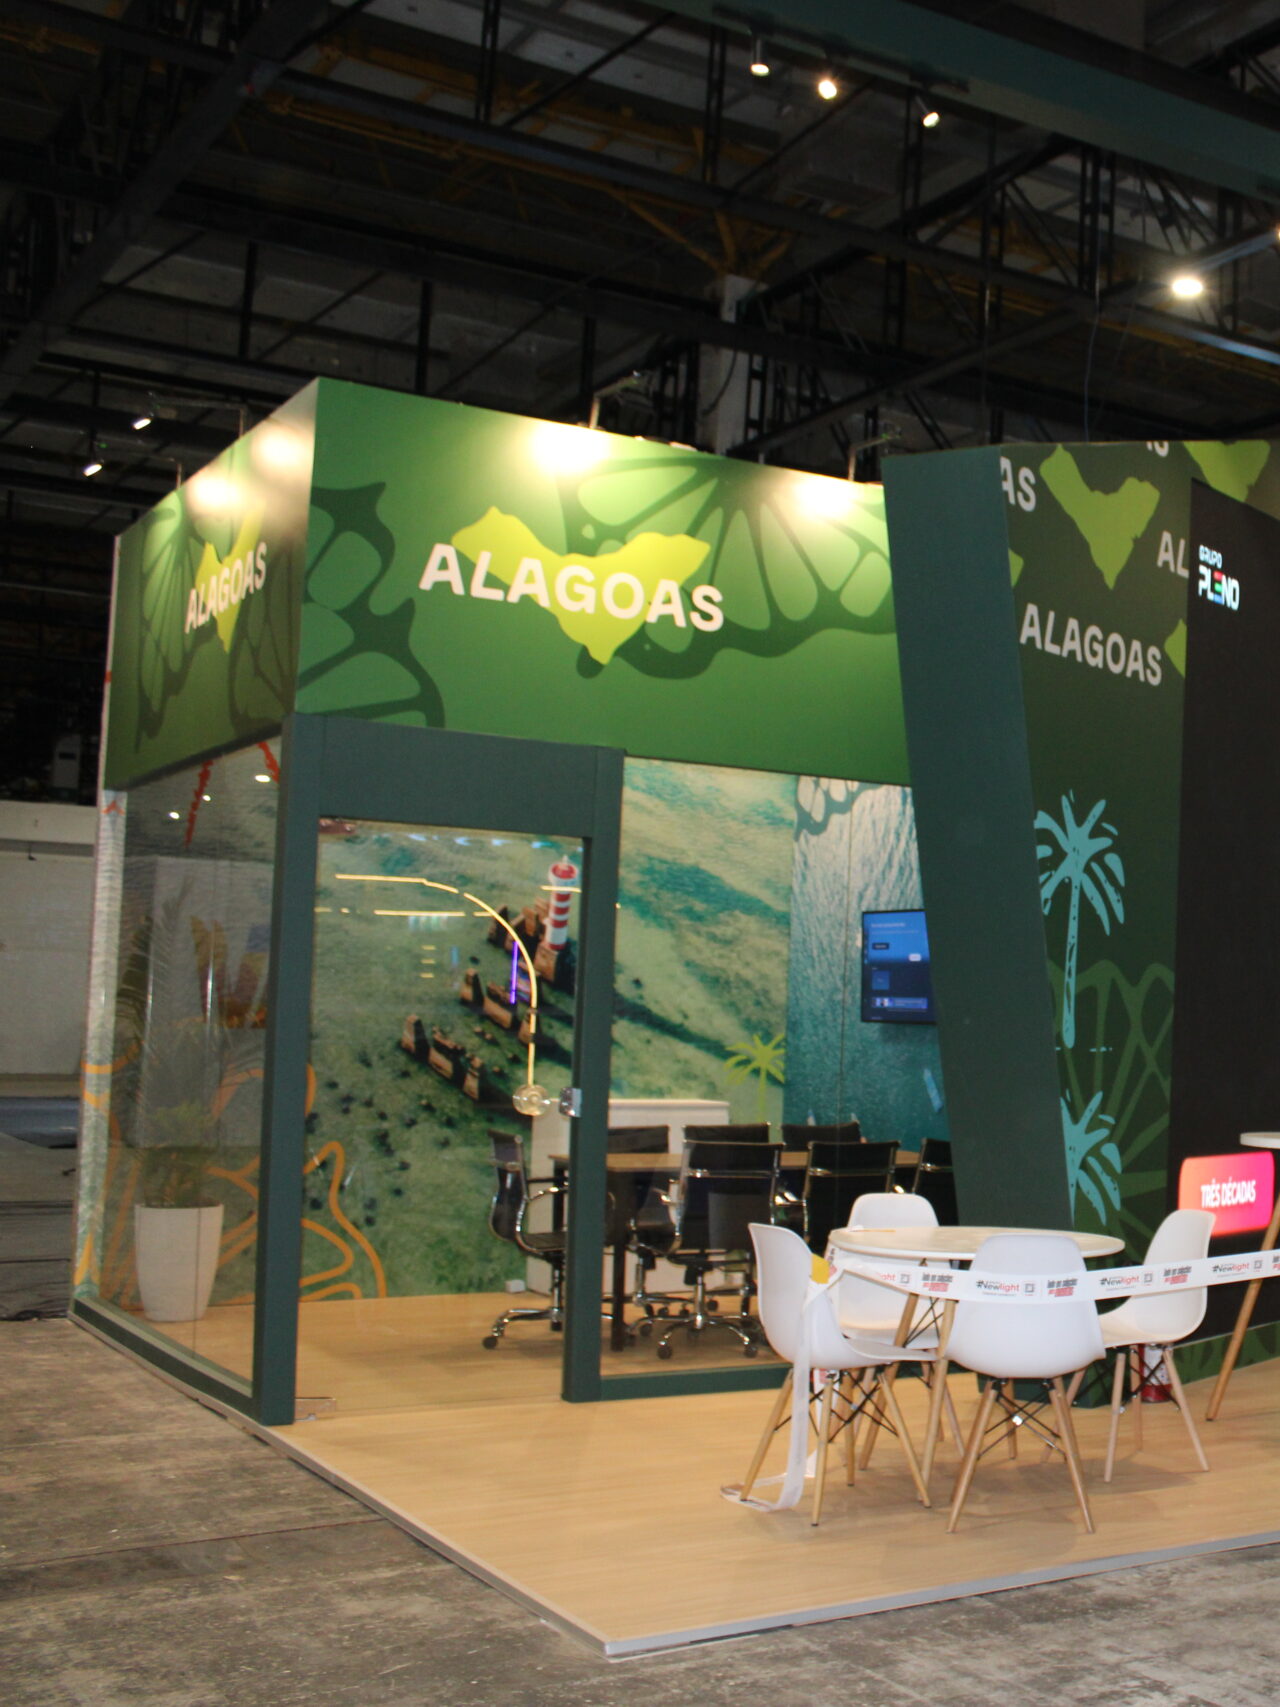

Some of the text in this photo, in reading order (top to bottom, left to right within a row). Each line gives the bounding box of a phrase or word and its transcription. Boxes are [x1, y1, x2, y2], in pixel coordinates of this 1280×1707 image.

[184, 541, 267, 635] ALAGOAS
[418, 542, 725, 632] ALAGOAS
[1198, 544, 1223, 569] GRUPO
[1198, 563, 1240, 611] PLENO
[1019, 602, 1163, 686] ALAGOAS
[1200, 1175, 1257, 1209] TRÊS DÉCADAS
